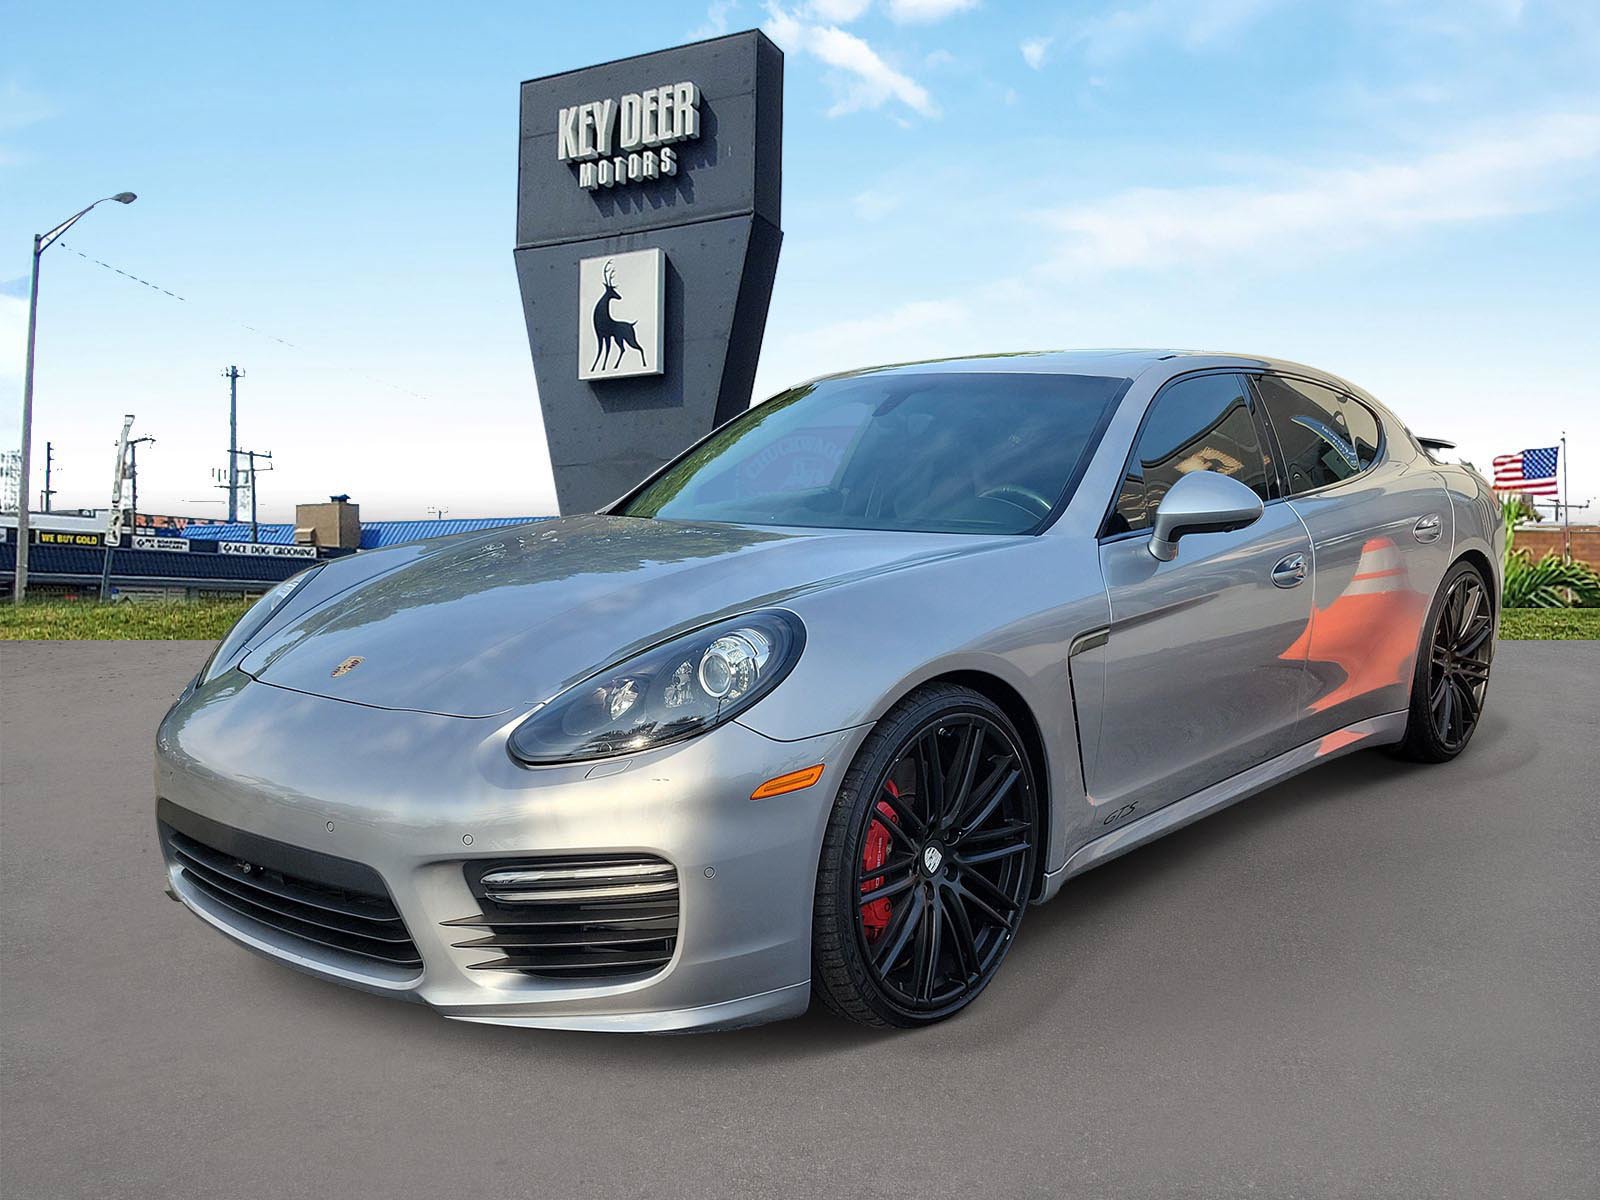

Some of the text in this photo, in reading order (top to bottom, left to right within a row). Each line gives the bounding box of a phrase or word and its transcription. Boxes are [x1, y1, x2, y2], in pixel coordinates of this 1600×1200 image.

[558, 81, 700, 162] KEY DEER
[579, 147, 677, 189] MOTORS
[41, 533, 98, 545] WE BUY GOLD
[233, 544, 315, 557] ACE DOG GROOMING
[1103, 800, 1139, 825] GTS
